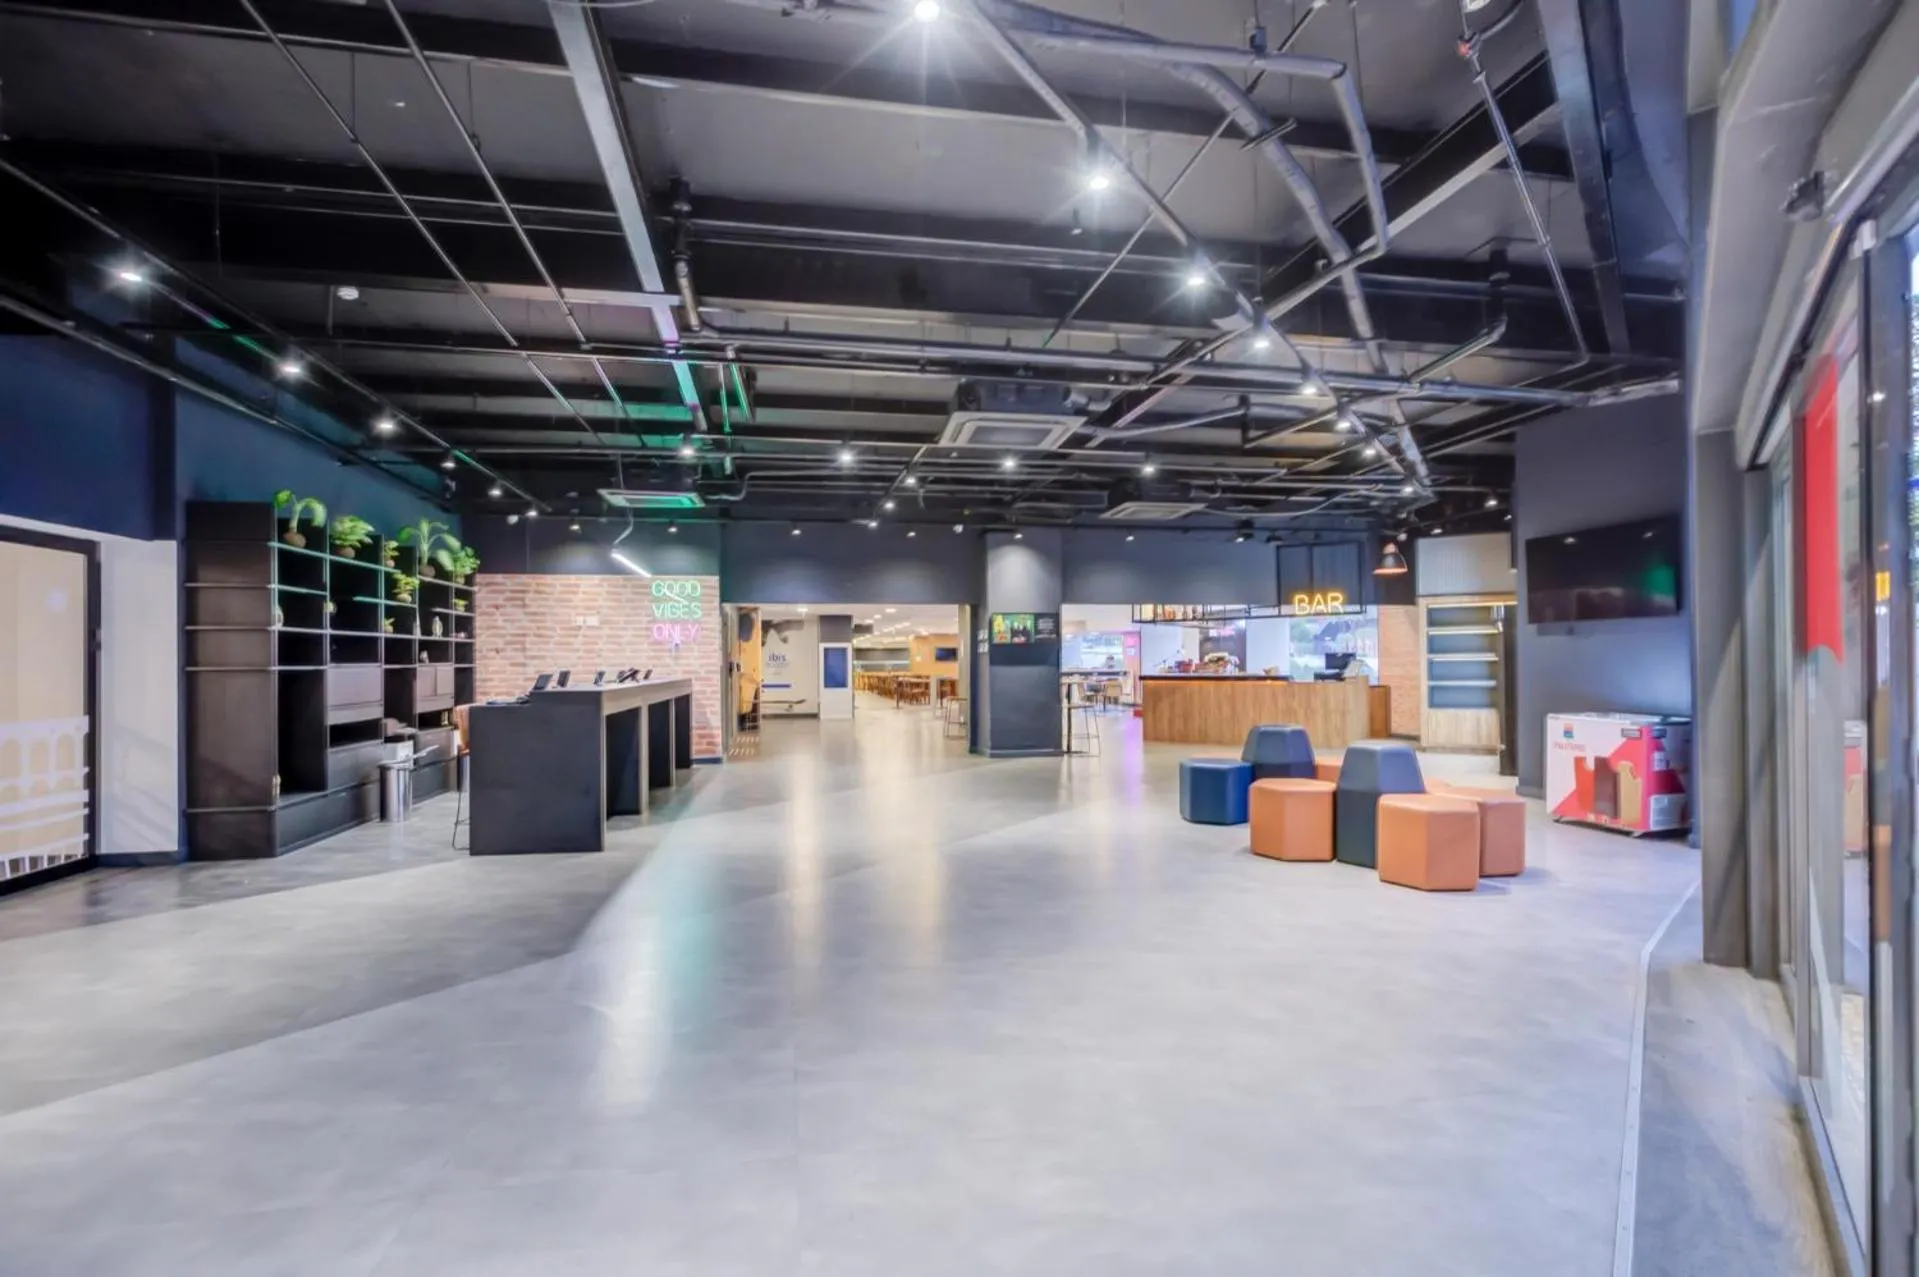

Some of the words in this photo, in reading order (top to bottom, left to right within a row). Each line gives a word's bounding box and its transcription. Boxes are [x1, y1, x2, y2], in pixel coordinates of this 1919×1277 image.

[652, 580, 701, 597] GOOD
[652, 602, 702, 619] VIBES
[1293, 592, 1344, 615] BAR
[653, 623, 700, 640] ONLY
[768, 651, 787, 662] ibis
